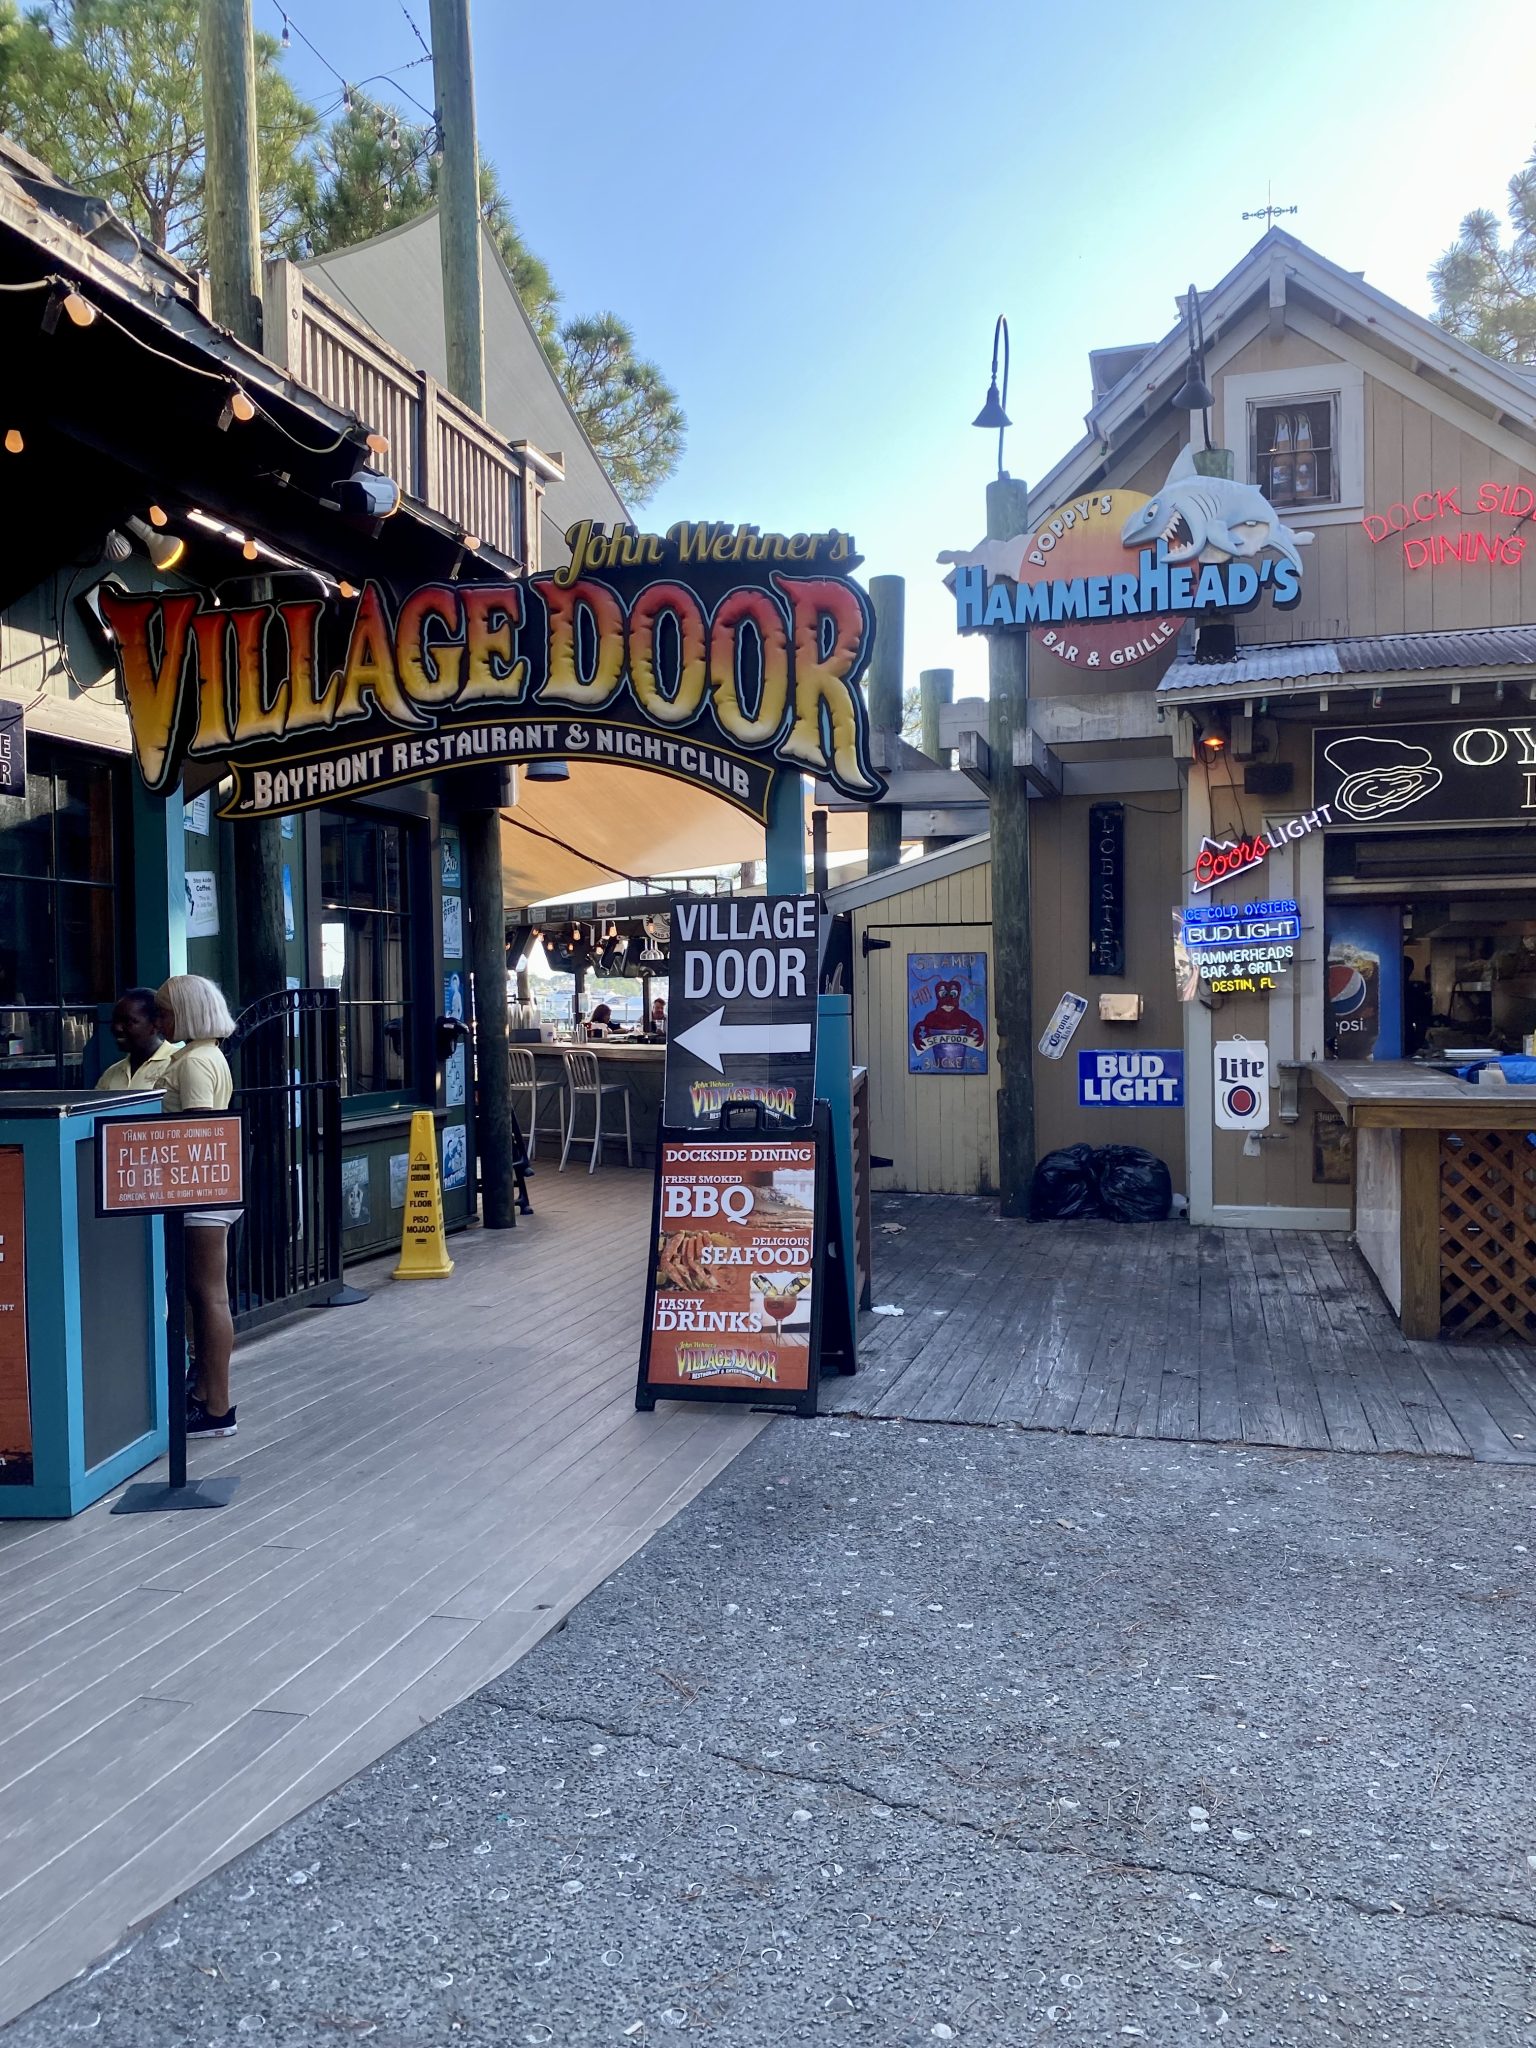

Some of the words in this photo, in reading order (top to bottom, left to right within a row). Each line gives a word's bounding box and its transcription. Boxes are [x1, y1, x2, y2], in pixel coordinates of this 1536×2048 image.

[1361, 486, 1461, 544] DOCK
[1476, 482, 1536, 522] SID
[1028, 494, 1113, 567] POPPY'S
[553, 519, 664, 588] John
[666, 520, 853, 562] Wehner's
[1403, 531, 1527, 570] DINING
[955, 538, 1298, 632] HAMMERHEAD'S
[1041, 630, 1078, 663] BAR
[1086, 651, 1101, 667] &
[1109, 621, 1176, 666] GRILLE
[100, 580, 527, 789] VILLAGE
[530, 572, 884, 794] DOOR
[253, 746, 384, 810] BAYFRONT
[392, 724, 558, 773] RESTAURANT
[564, 723, 590, 750] &
[596, 727, 750, 799] NIGHTCLUB
[1196, 835, 1270, 883] Coors
[1266, 803, 1333, 849] LIGHT
[675, 900, 816, 942] VILLAGE
[1184, 909, 1201, 921] ICE
[1207, 904, 1239, 919] COLD
[1244, 900, 1297, 916] OYSTERS
[1188, 925, 1233, 943] BUD
[1235, 920, 1295, 940] LIGHT
[684, 947, 806, 1000] DOOR
[1200, 964, 1229, 979] BAR
[1232, 963, 1247, 977] &
[1248, 960, 1288, 975] GRILL
[1212, 978, 1256, 993] DESTIN,
[1260, 977, 1277, 989] FL
[1049, 1014, 1071, 1047] Corona
[1335, 1017, 1364, 1034] psi
[926, 1034, 968, 1046] SEAFOOD
[1096, 1055, 1165, 1078] BUD
[1218, 1057, 1265, 1085] Lite
[1084, 1078, 1178, 1102] LIGHT
[122, 1128, 147, 1142] THANK
[150, 1130, 165, 1140] YOU
[166, 1129, 181, 1139] FOR
[183, 1128, 212, 1138] JOINING
[214, 1127, 224, 1137] US
[119, 1145, 180, 1167] PLEASE
[187, 1142, 228, 1163] WAIT
[665, 1149, 747, 1162] DOCKSIDE
[751, 1148, 812, 1162] DINING
[117, 1169, 136, 1188] TO
[143, 1168, 163, 1187] BE
[170, 1163, 231, 1185] SEATED
[664, 1175, 696, 1184] FRESH
[698, 1175, 743, 1184] SMOKED
[149, 1191, 165, 1200] WILL
[196, 1188, 213, 1197] WITH
[410, 1200, 433, 1208] FLOOR
[413, 1190, 429, 1198] WET
[664, 1185, 755, 1225] BBQ
[407, 1225, 436, 1233] MOJADO
[413, 1216, 429, 1224] PISO
[752, 1237, 810, 1246] DELICIOUS
[700, 1246, 810, 1265] SEAFOOD
[658, 1298, 705, 1311] TASTY
[656, 1310, 763, 1333] DRINKS
[674, 1346, 734, 1377] VILLAGE
[734, 1348, 779, 1383] DOOR
